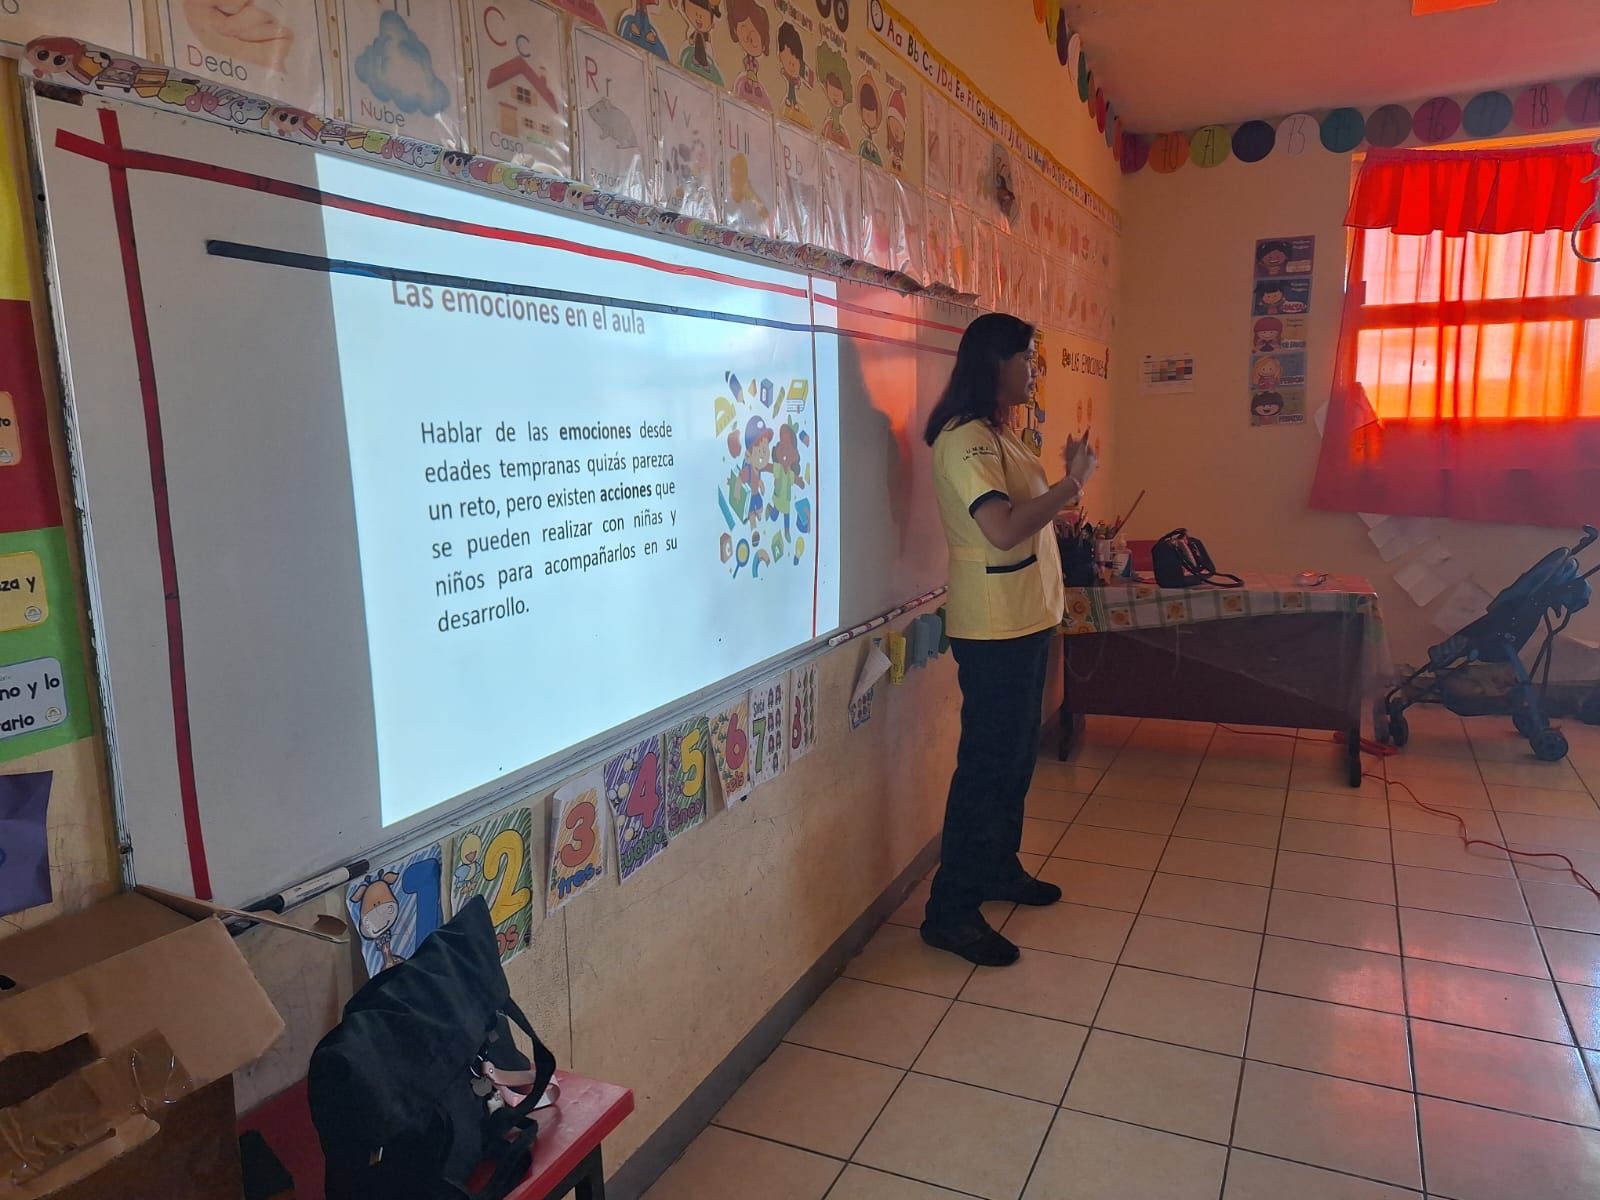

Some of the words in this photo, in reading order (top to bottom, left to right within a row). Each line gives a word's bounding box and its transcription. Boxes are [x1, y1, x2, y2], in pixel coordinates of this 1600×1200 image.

[887, 18, 902, 47] Aa
[908, 37, 919, 62] Bb
[186, 44, 248, 81] Dedo
[360, 99, 405, 128] Nube
[1528, 85, 1549, 129] 78
[490, 131, 523, 154] Casa
[1203, 129, 1215, 167] 71
[391, 277, 434, 309] Las
[441, 288, 560, 325] emociones
[565, 305, 588, 328] en
[593, 304, 608, 330] el
[612, 309, 646, 335] aula
[421, 421, 482, 444] Hablar
[495, 421, 516, 442] de
[528, 421, 549, 441] las
[559, 421, 632, 441] emociones
[639, 420, 673, 438] desde
[425, 459, 491, 483] edades
[500, 458, 581, 481] tempranas
[587, 451, 627, 477] quizás
[632, 453, 674, 473] parezca
[428, 502, 453, 521] un
[459, 496, 501, 519] reto,
[506, 494, 542, 518] pero
[547, 487, 596, 508] existen
[600, 482, 652, 502] acciones
[655, 480, 676, 497] que
[432, 541, 452, 559] se
[467, 528, 531, 559] pueden
[542, 520, 592, 543] realizar
[602, 516, 624, 533] con
[633, 508, 663, 529] niñas
[670, 508, 677, 526] y
[26, 576, 36, 593] y
[435, 570, 485, 597] niños
[498, 564, 533, 589] para
[544, 542, 636, 576] acompañarlos
[644, 539, 658, 555] en
[666, 536, 678, 551] su
[438, 595, 530, 633] desarrollo.
[27, 682, 37, 700] y
[44, 673, 60, 690] lo
[0, 714, 35, 732] ario
[725, 712, 747, 770] 6
[680, 727, 705, 798] 5
[752, 716, 767, 774] 7
[626, 751, 660, 829] 4
[560, 801, 596, 868] 3
[669, 799, 703, 832] cinco
[620, 825, 665, 873] cuatro
[483, 829, 532, 928] 2
[558, 863, 595, 900] tres
[402, 858, 441, 949] 1
[496, 924, 519, 957] os
